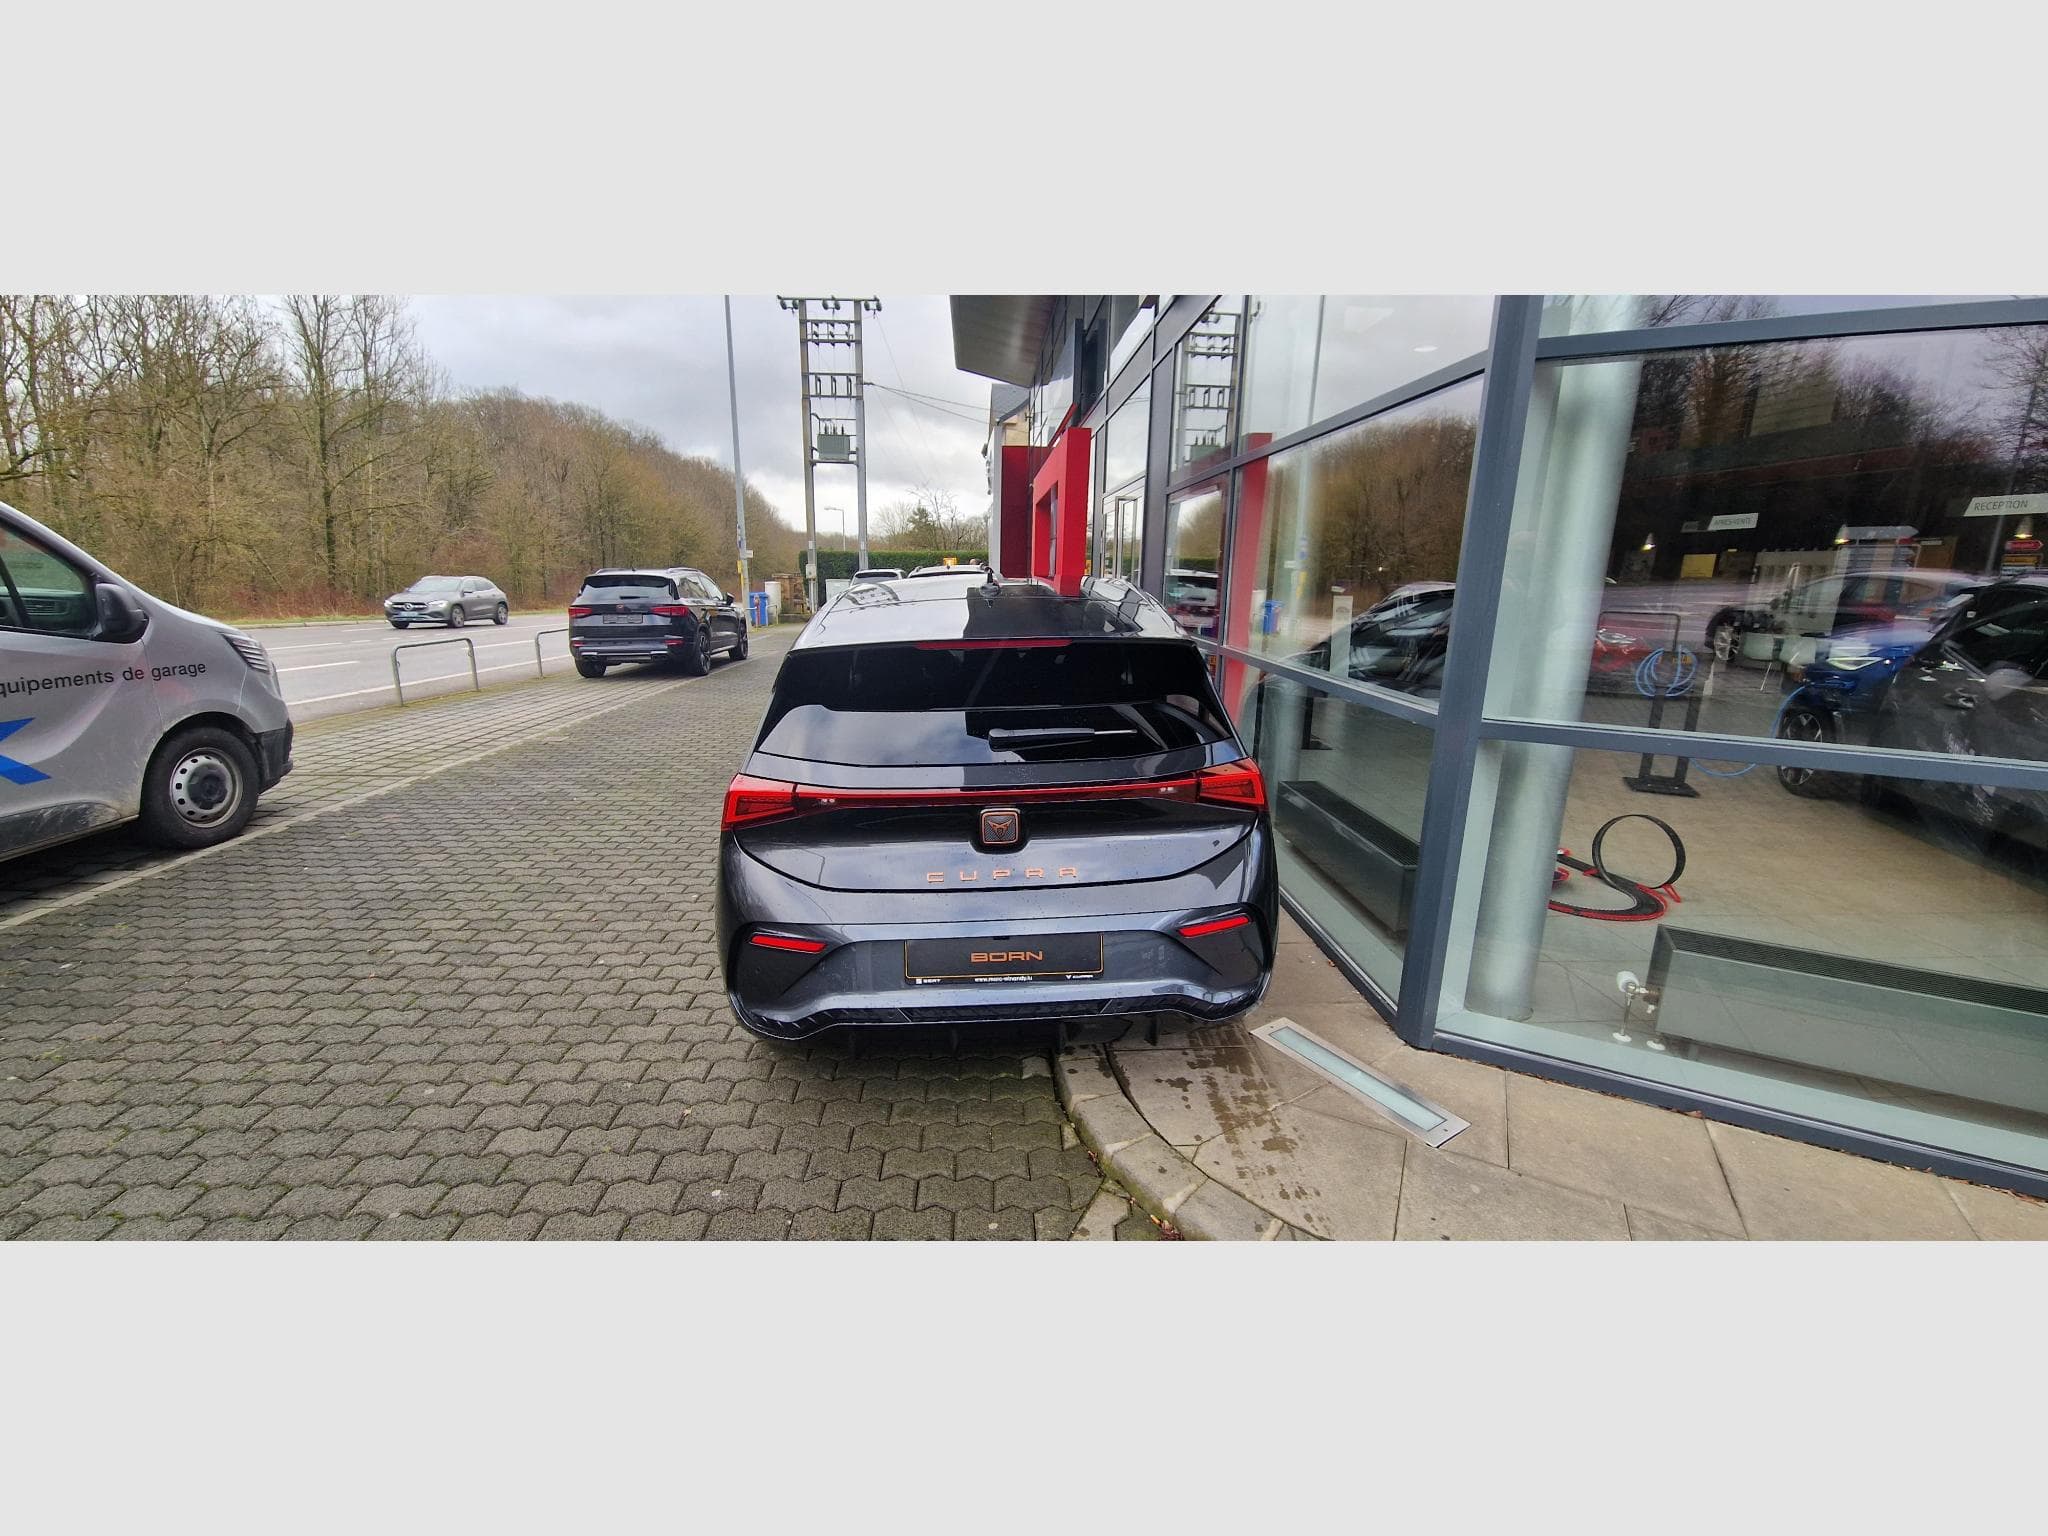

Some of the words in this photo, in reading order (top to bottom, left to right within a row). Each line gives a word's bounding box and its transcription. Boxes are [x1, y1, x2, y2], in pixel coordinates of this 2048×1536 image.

[122, 667, 145, 681] de
[151, 663, 206, 682] garage
[926, 866, 1078, 883] CUPRA
[970, 951, 1043, 963] BORN
